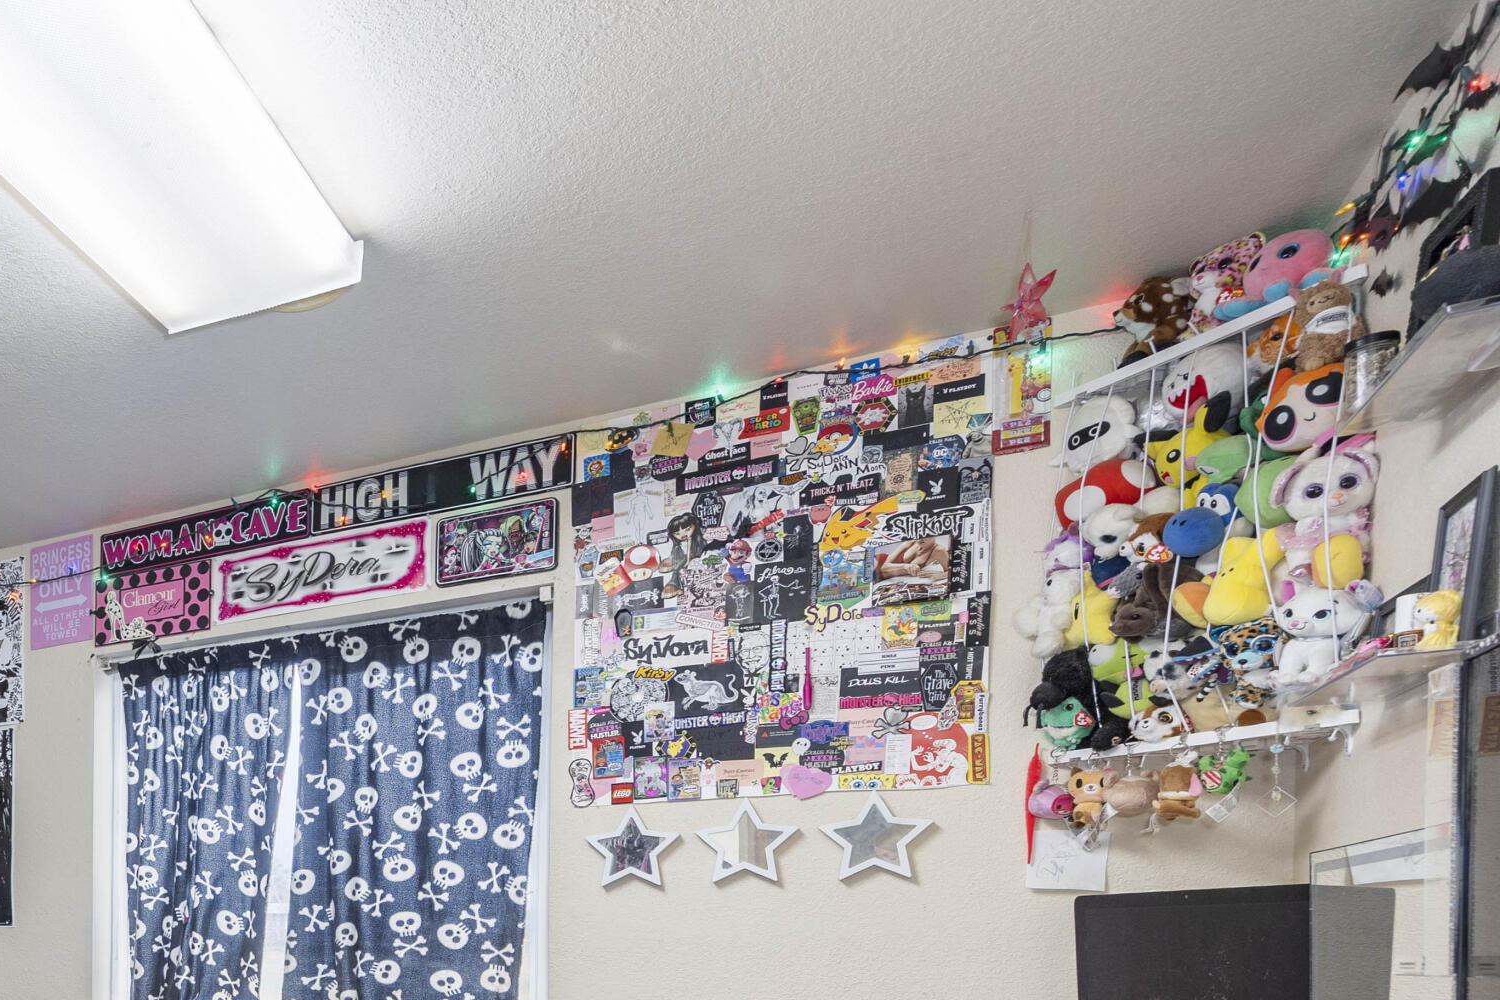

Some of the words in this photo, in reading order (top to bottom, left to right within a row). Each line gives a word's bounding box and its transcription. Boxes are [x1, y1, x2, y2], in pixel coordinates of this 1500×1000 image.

[853, 378, 895, 400] Barbie
[949, 383, 977, 393] PLAYBOY
[746, 419, 782, 433] MARIO
[705, 449, 729, 460] Ghost
[933, 447, 948, 458] DC
[652, 463, 684, 476] HUSTLER
[832, 456, 859, 473] ANN
[321, 471, 408, 529] HIGH
[470, 437, 566, 500] WAY
[685, 470, 731, 490] MONSTER
[747, 462, 773, 477] HIGH
[810, 485, 835, 500] TRICKZ
[697, 504, 722, 517] Grave
[102, 521, 216, 570] WOMAN
[228, 500, 308, 543] CAVE
[33, 541, 91, 567] PRINCESS
[39, 577, 83, 598] ONLY
[123, 587, 176, 608] Glamour
[148, 599, 180, 616] Girl
[33, 615, 49, 625] ALL
[53, 609, 90, 623] OTHERS
[678, 614, 721, 629] CONVICTED
[43, 622, 65, 633] WILL
[68, 619, 81, 629] BE
[45, 629, 78, 641] TOWED
[771, 619, 787, 658] MONSTER
[920, 652, 957, 662] HUSTLER
[635, 666, 675, 682] Kirby
[770, 670, 785, 691] HIGH
[935, 669, 947, 678] The
[847, 677, 883, 688] DOLLS
[885, 675, 910, 685] KILL
[924, 676, 953, 691] Grave
[840, 694, 883, 709] MONSTER
[899, 693, 922, 706] HIGH
[928, 691, 946, 703] Girls
[722, 711, 747, 725] HIGH
[569, 709, 587, 749] MARVEL
[591, 730, 620, 740] HUSTLER
[973, 735, 984, 779] PAC-MAN
[831, 762, 880, 775] PLAYBOY
[613, 789, 631, 798] LEGO
